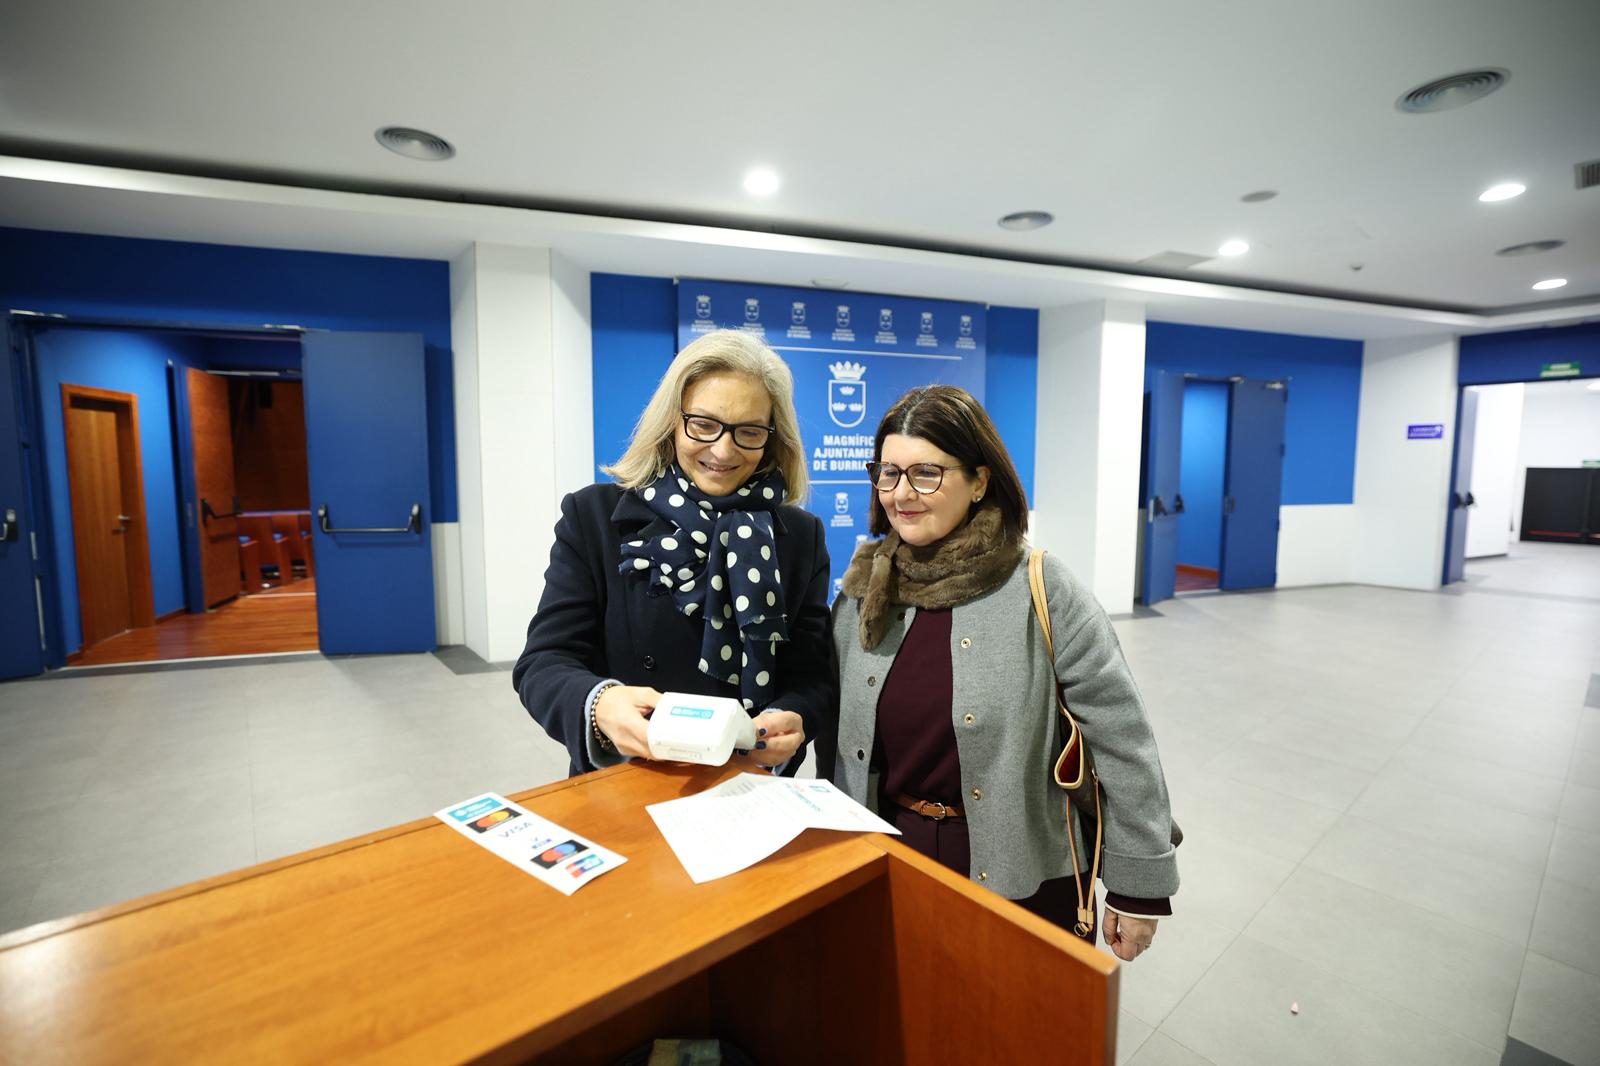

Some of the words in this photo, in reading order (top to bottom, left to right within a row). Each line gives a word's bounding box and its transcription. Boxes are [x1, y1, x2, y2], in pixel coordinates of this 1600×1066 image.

[813, 447, 875, 459] AJUNTAMEN
[813, 460, 827, 471] DE
[830, 460, 875, 471] BURRIA
